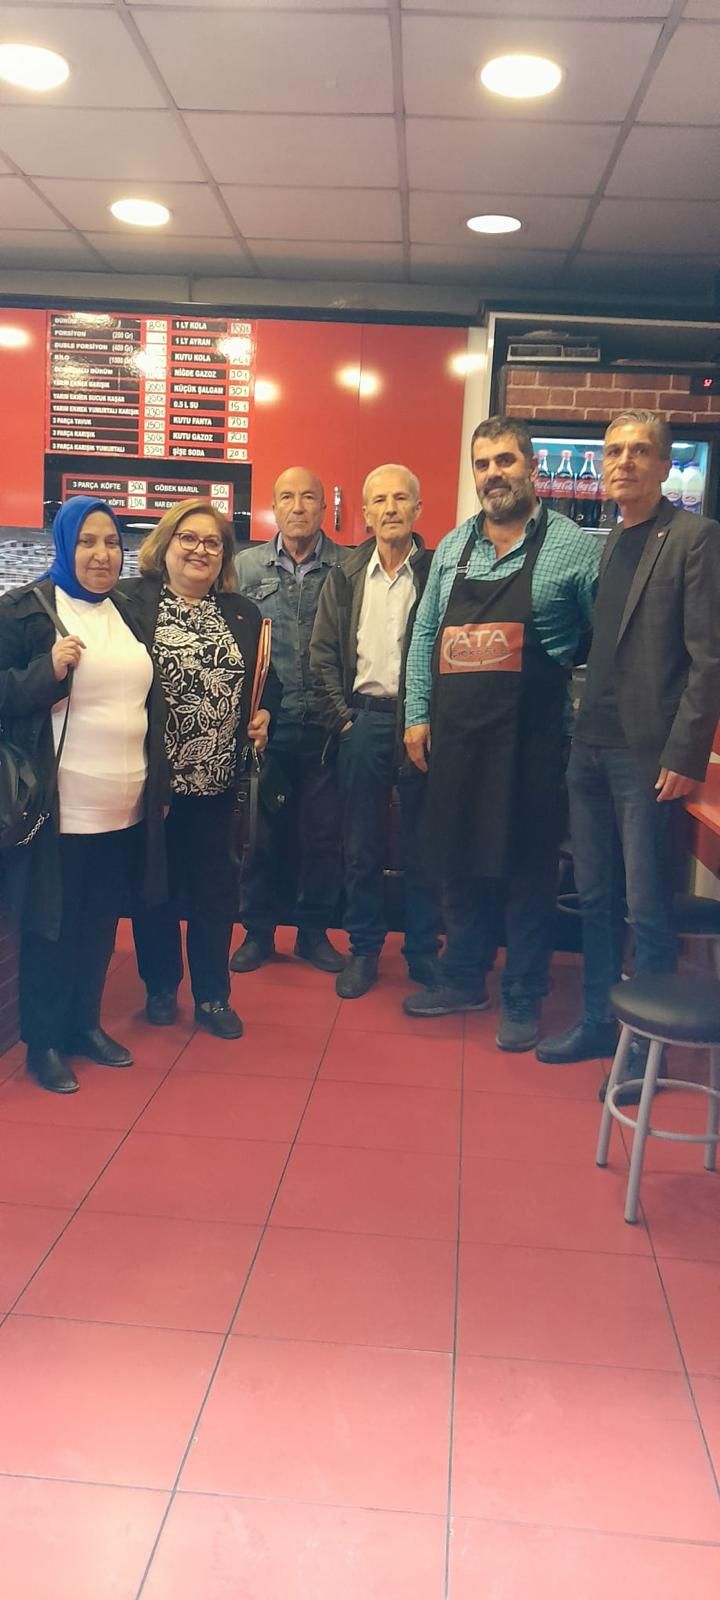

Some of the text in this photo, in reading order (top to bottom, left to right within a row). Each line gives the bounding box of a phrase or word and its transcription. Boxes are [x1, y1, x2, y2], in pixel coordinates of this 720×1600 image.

[189, 322, 207, 330] KOLA
[54, 342, 75, 350] DUBLE
[76, 343, 108, 351] PORSİYON
[189, 338, 211, 346] AYRAN
[174, 353, 211, 362] KUTU KOLA
[174, 367, 194, 377] NİĞDE
[195, 370, 217, 378] GAZOZ
[173, 385, 224, 395] KÜÇÜK ŞALGAM
[57, 417, 74, 425] PARÇA
[192, 417, 213, 426] FANTA
[172, 432, 214, 442] KUTU GAZOZ
[57, 443, 74, 451] PARÇA
[172, 447, 205, 457] ŞİŞE SODA
[78, 482, 98, 490] PARÇA
[100, 482, 121, 490] KÖFTE
[154, 483, 200, 493] GÖBEK MARUL
[452, 629, 509, 649] ATA
